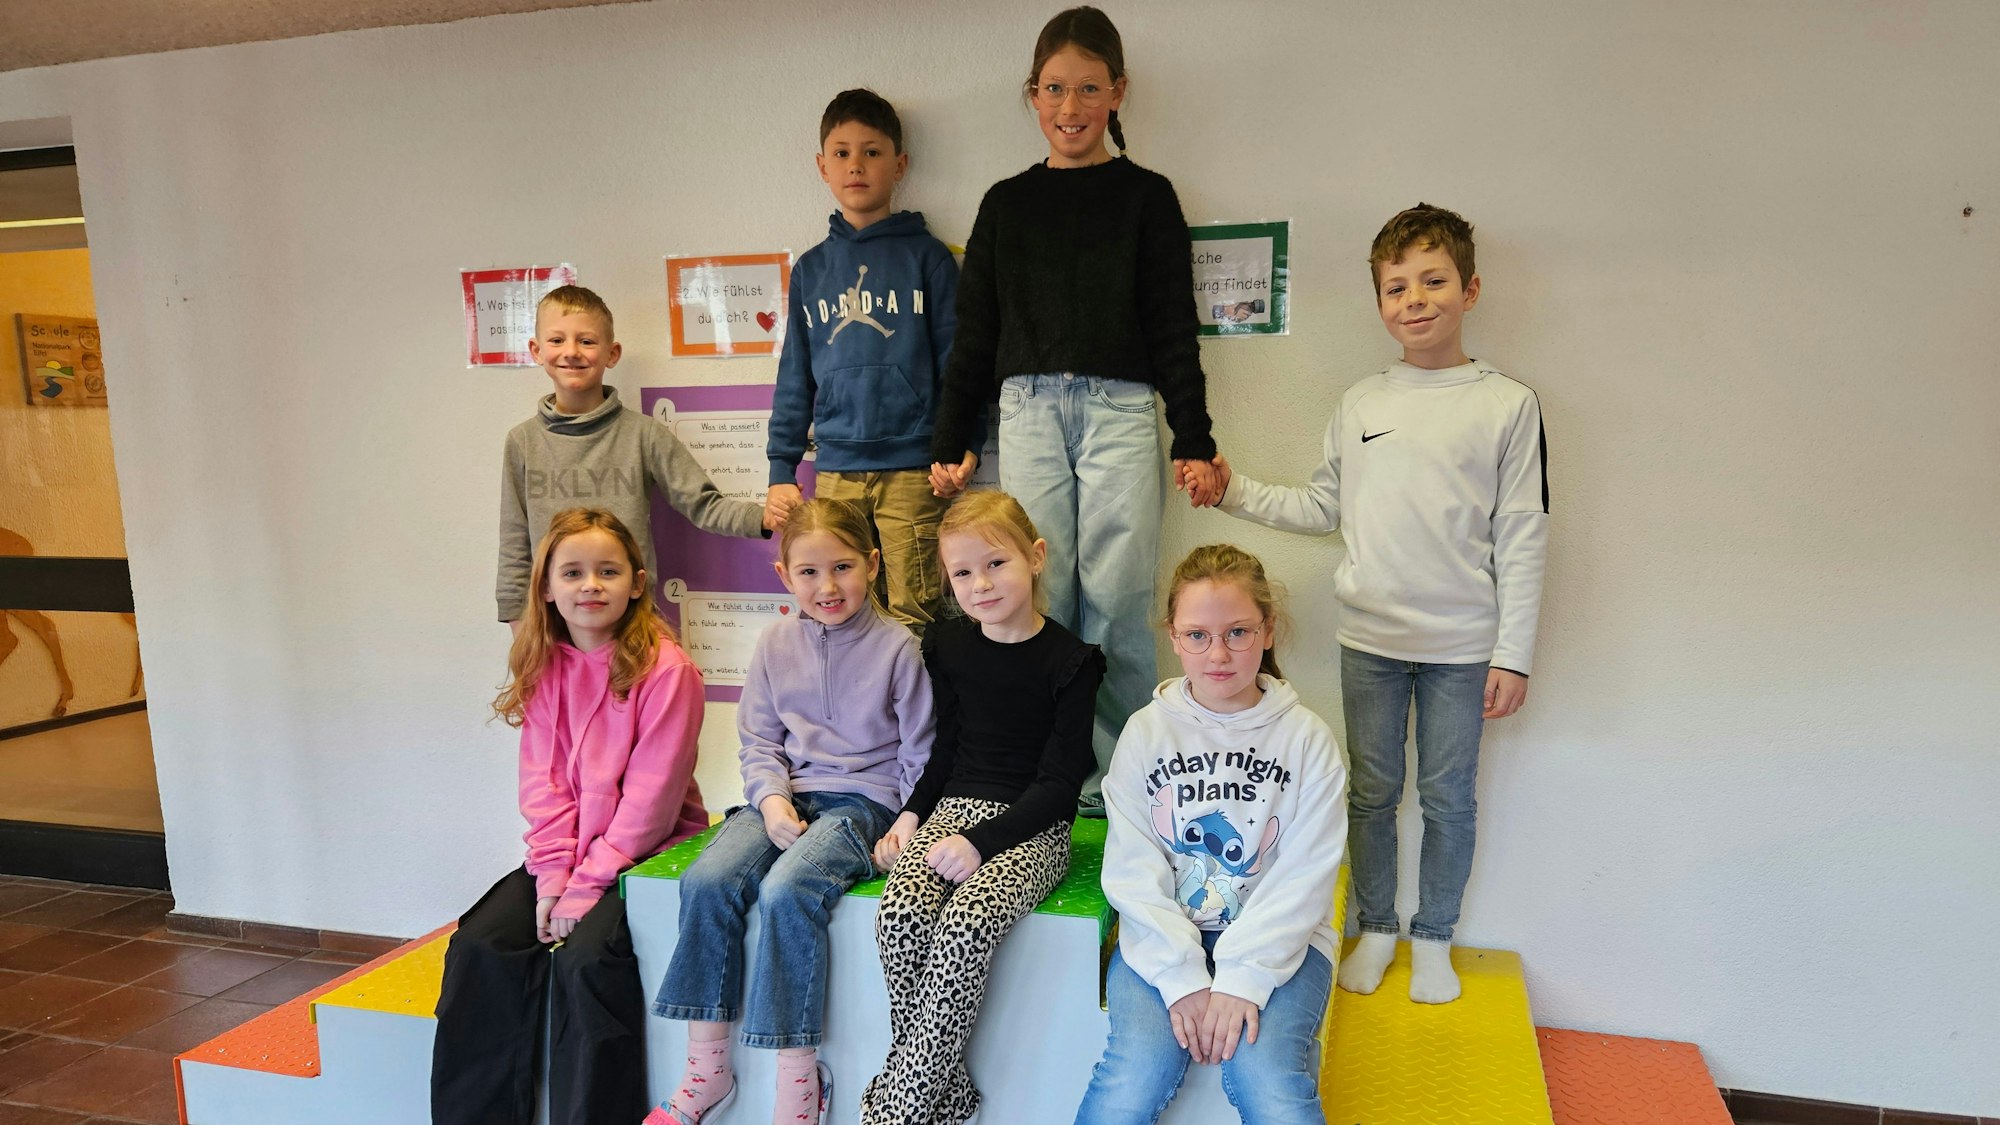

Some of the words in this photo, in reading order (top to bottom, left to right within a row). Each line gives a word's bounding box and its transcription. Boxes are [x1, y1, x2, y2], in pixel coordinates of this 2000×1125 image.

[1191, 252, 1222, 264] lche
[697, 286, 719, 298] We
[723, 285, 763, 297] fühlst
[1193, 281, 1219, 294] ung
[1224, 278, 1268, 290] findet
[477, 301, 484, 311] 1.
[487, 300, 508, 311] Was
[698, 313, 711, 325] du
[661, 406, 672, 423] 1.
[701, 422, 715, 431] Was
[719, 423, 727, 431] ist
[730, 421, 761, 431] passiert?
[690, 441, 705, 449] habe
[738, 441, 754, 449] dass
[736, 466, 751, 474] dass
[527, 466, 638, 500] BKLYN
[671, 581, 684, 598] 2.
[707, 602, 720, 610] Wie
[723, 602, 742, 610] fühlst
[702, 620, 717, 628] fühle
[1225, 747, 1292, 792] night
